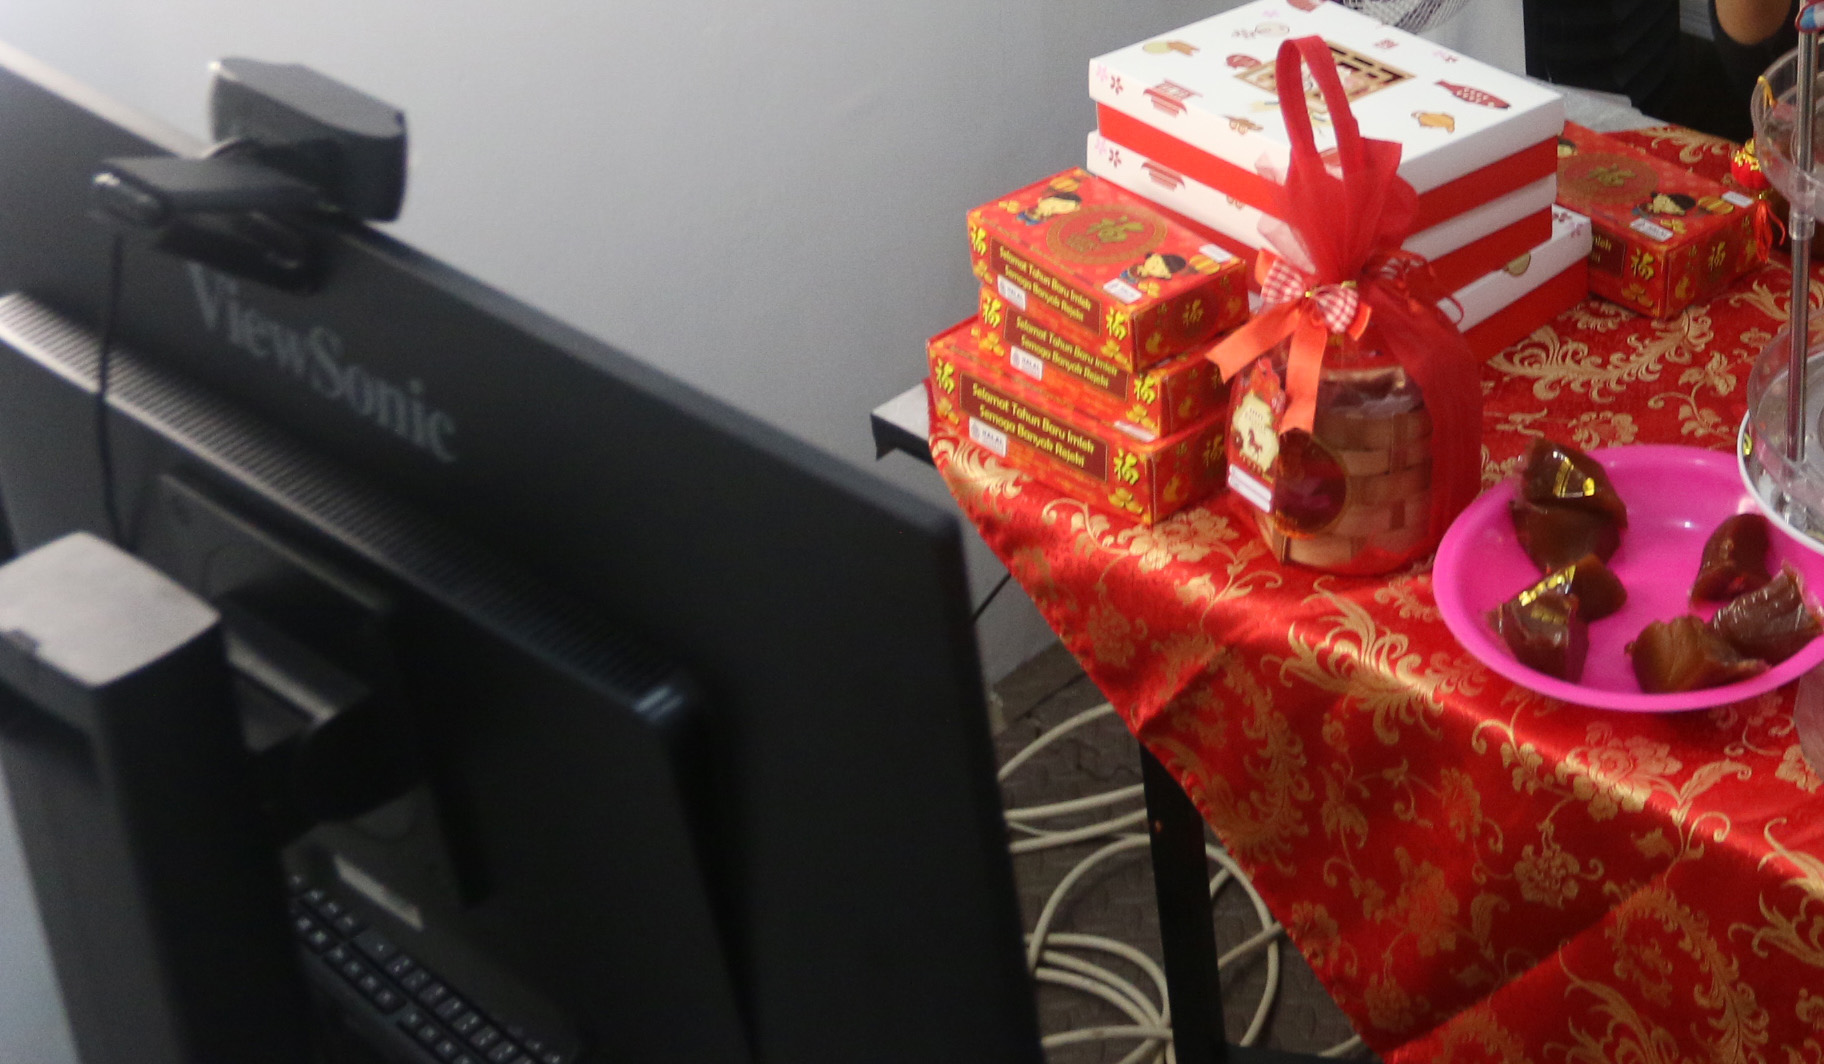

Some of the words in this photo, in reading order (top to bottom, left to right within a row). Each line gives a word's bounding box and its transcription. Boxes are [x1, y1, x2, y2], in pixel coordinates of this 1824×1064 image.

[1000, 245, 1027, 272] Selamat
[1029, 264, 1051, 287] Tahun
[1052, 277, 1069, 298] Baru
[1017, 316, 1047, 341] Selamat
[1049, 333, 1073, 355] Tahun
[1074, 345, 1094, 365] Baru
[1106, 306, 1127, 340] 福
[187, 262, 458, 463] ViewSonic
[1021, 335, 1051, 359] Semoga
[935, 357, 955, 394] 福
[1134, 373, 1156, 404] 福
[973, 383, 1009, 411] Selamat
[1012, 401, 1040, 428] Tahun
[1042, 417, 1066, 440] Baru
[979, 404, 1015, 434] Semoga
[1018, 422, 1054, 452] Banyak
[1055, 442, 1085, 468] Rejeki
[1113, 447, 1140, 485] 福
